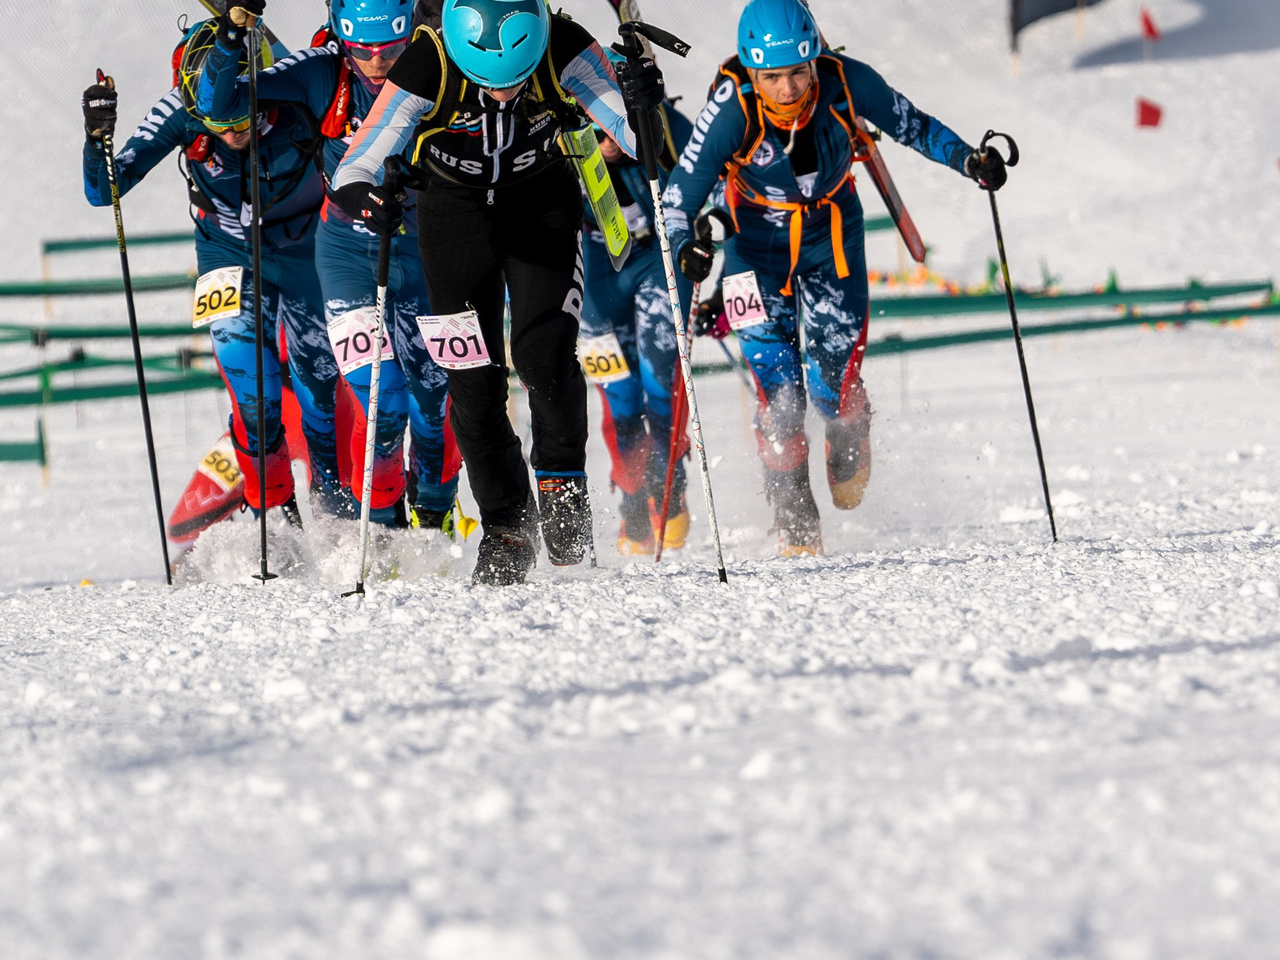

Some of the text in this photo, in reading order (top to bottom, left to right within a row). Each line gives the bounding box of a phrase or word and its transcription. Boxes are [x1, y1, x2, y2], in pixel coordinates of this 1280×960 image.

[196, 286, 237, 316] 502
[726, 292, 761, 319] 704
[430, 334, 482, 358] 701
[585, 353, 622, 374] 501
[205, 450, 240, 483] 503
